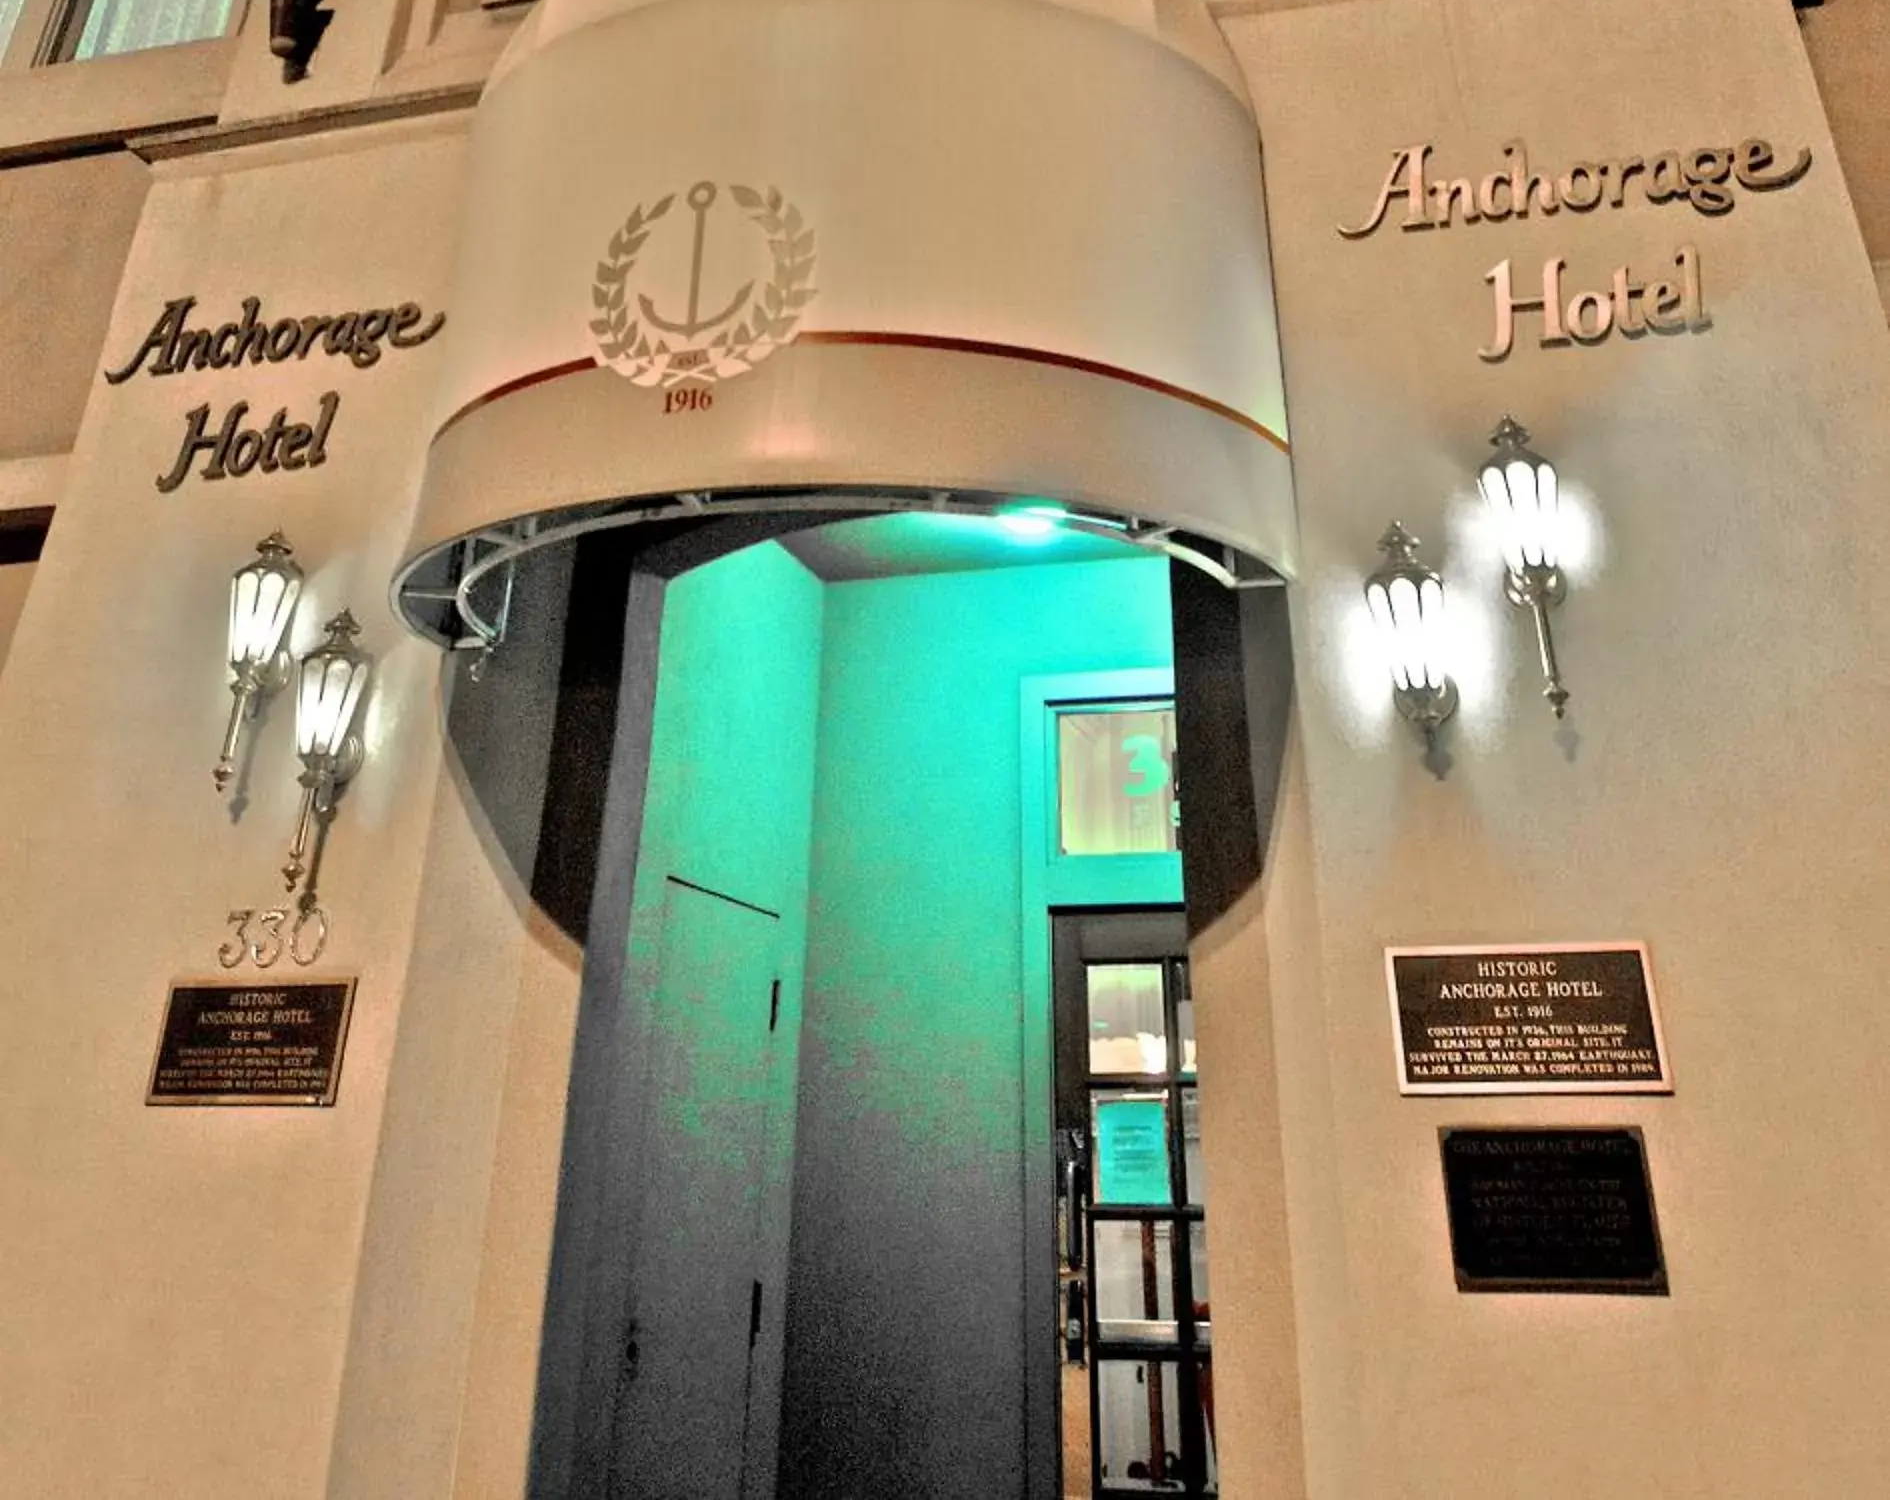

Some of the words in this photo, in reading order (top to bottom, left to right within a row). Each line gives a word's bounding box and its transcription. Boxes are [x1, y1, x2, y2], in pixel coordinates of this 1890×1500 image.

[1336, 136, 1813, 241] Anchorage
[1477, 243, 1714, 364] Hotel
[104, 294, 447, 386] Anchorage
[662, 387, 714, 415] 1916
[154, 389, 341, 494] Hotel
[218, 907, 328, 969] 330
[1477, 960, 1558, 978] HISTORIC
[1439, 981, 1541, 999] ANCHORAGE
[1546, 980, 1603, 998] HOTEL
[229, 991, 288, 1007] HISTORIC
[198, 1011, 270, 1025] ANCHORAGE
[272, 1008, 315, 1024] HOTEL
[1494, 1005, 1523, 1019] EST.
[1527, 1004, 1553, 1018] 1916
[1427, 1025, 1504, 1038] CONSTRUCTED
[1506, 1025, 1519, 1036] IN
[1549, 1024, 1574, 1036] THIS
[1577, 1023, 1627, 1036] BUILDING
[1434, 1038, 1483, 1050] REMAINS
[1486, 1037, 1501, 1050] ON
[1527, 1036, 1579, 1049] ORIGINAL
[1409, 1051, 1463, 1063] SURVIVED
[1464, 1050, 1489, 1062] THE
[1491, 1050, 1531, 1062] MARCH
[1413, 1064, 1449, 1076] MAJOR
[1453, 1063, 1520, 1076] RENOVATION
[1522, 1063, 1547, 1075] WAS
[1549, 1062, 1614, 1075] COMPLETED
